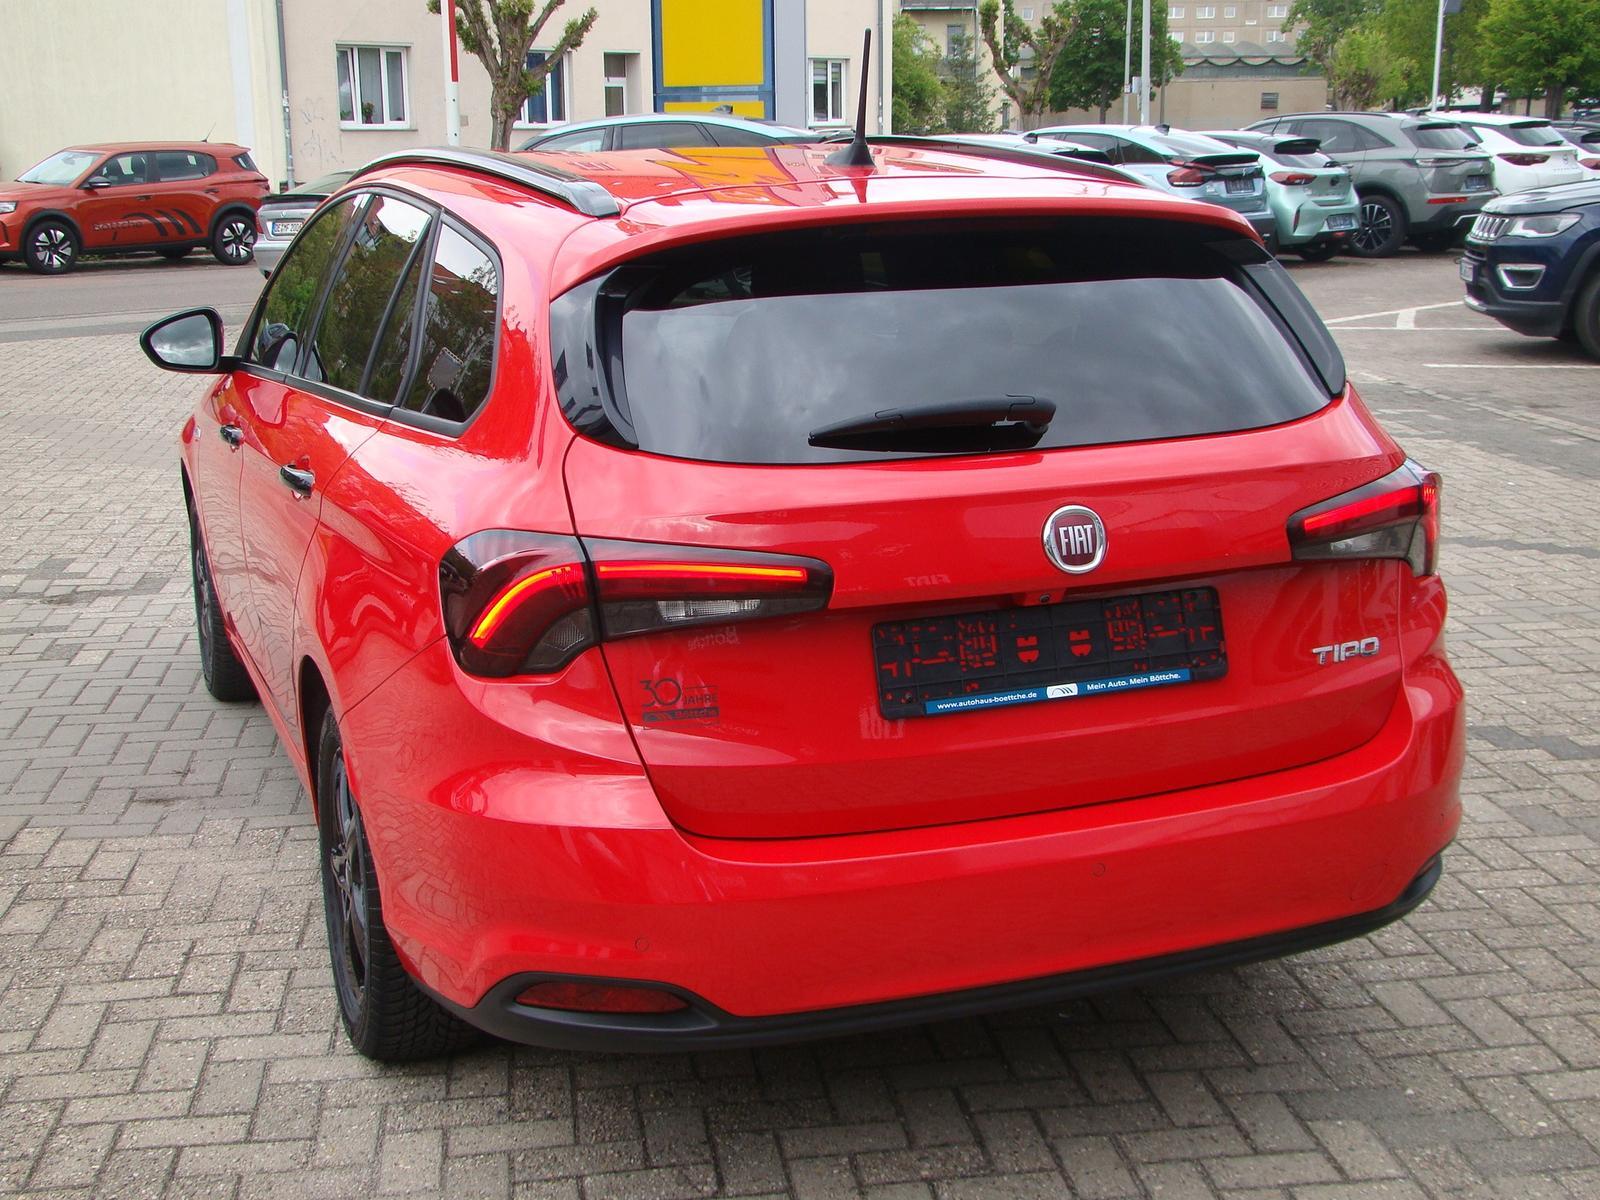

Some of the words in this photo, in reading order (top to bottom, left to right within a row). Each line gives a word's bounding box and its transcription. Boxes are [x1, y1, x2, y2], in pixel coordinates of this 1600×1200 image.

[1059, 524, 1093, 556] FIAT
[1311, 636, 1380, 665] TIPO
[640, 677, 682, 707] 30
[1086, 682, 1106, 691] Mein
[1107, 679, 1129, 688] Auto.
[1129, 676, 1149, 685] Mein
[1149, 672, 1181, 681] Böttche.
[936, 691, 1038, 710] www.autohaus-boettche.de
